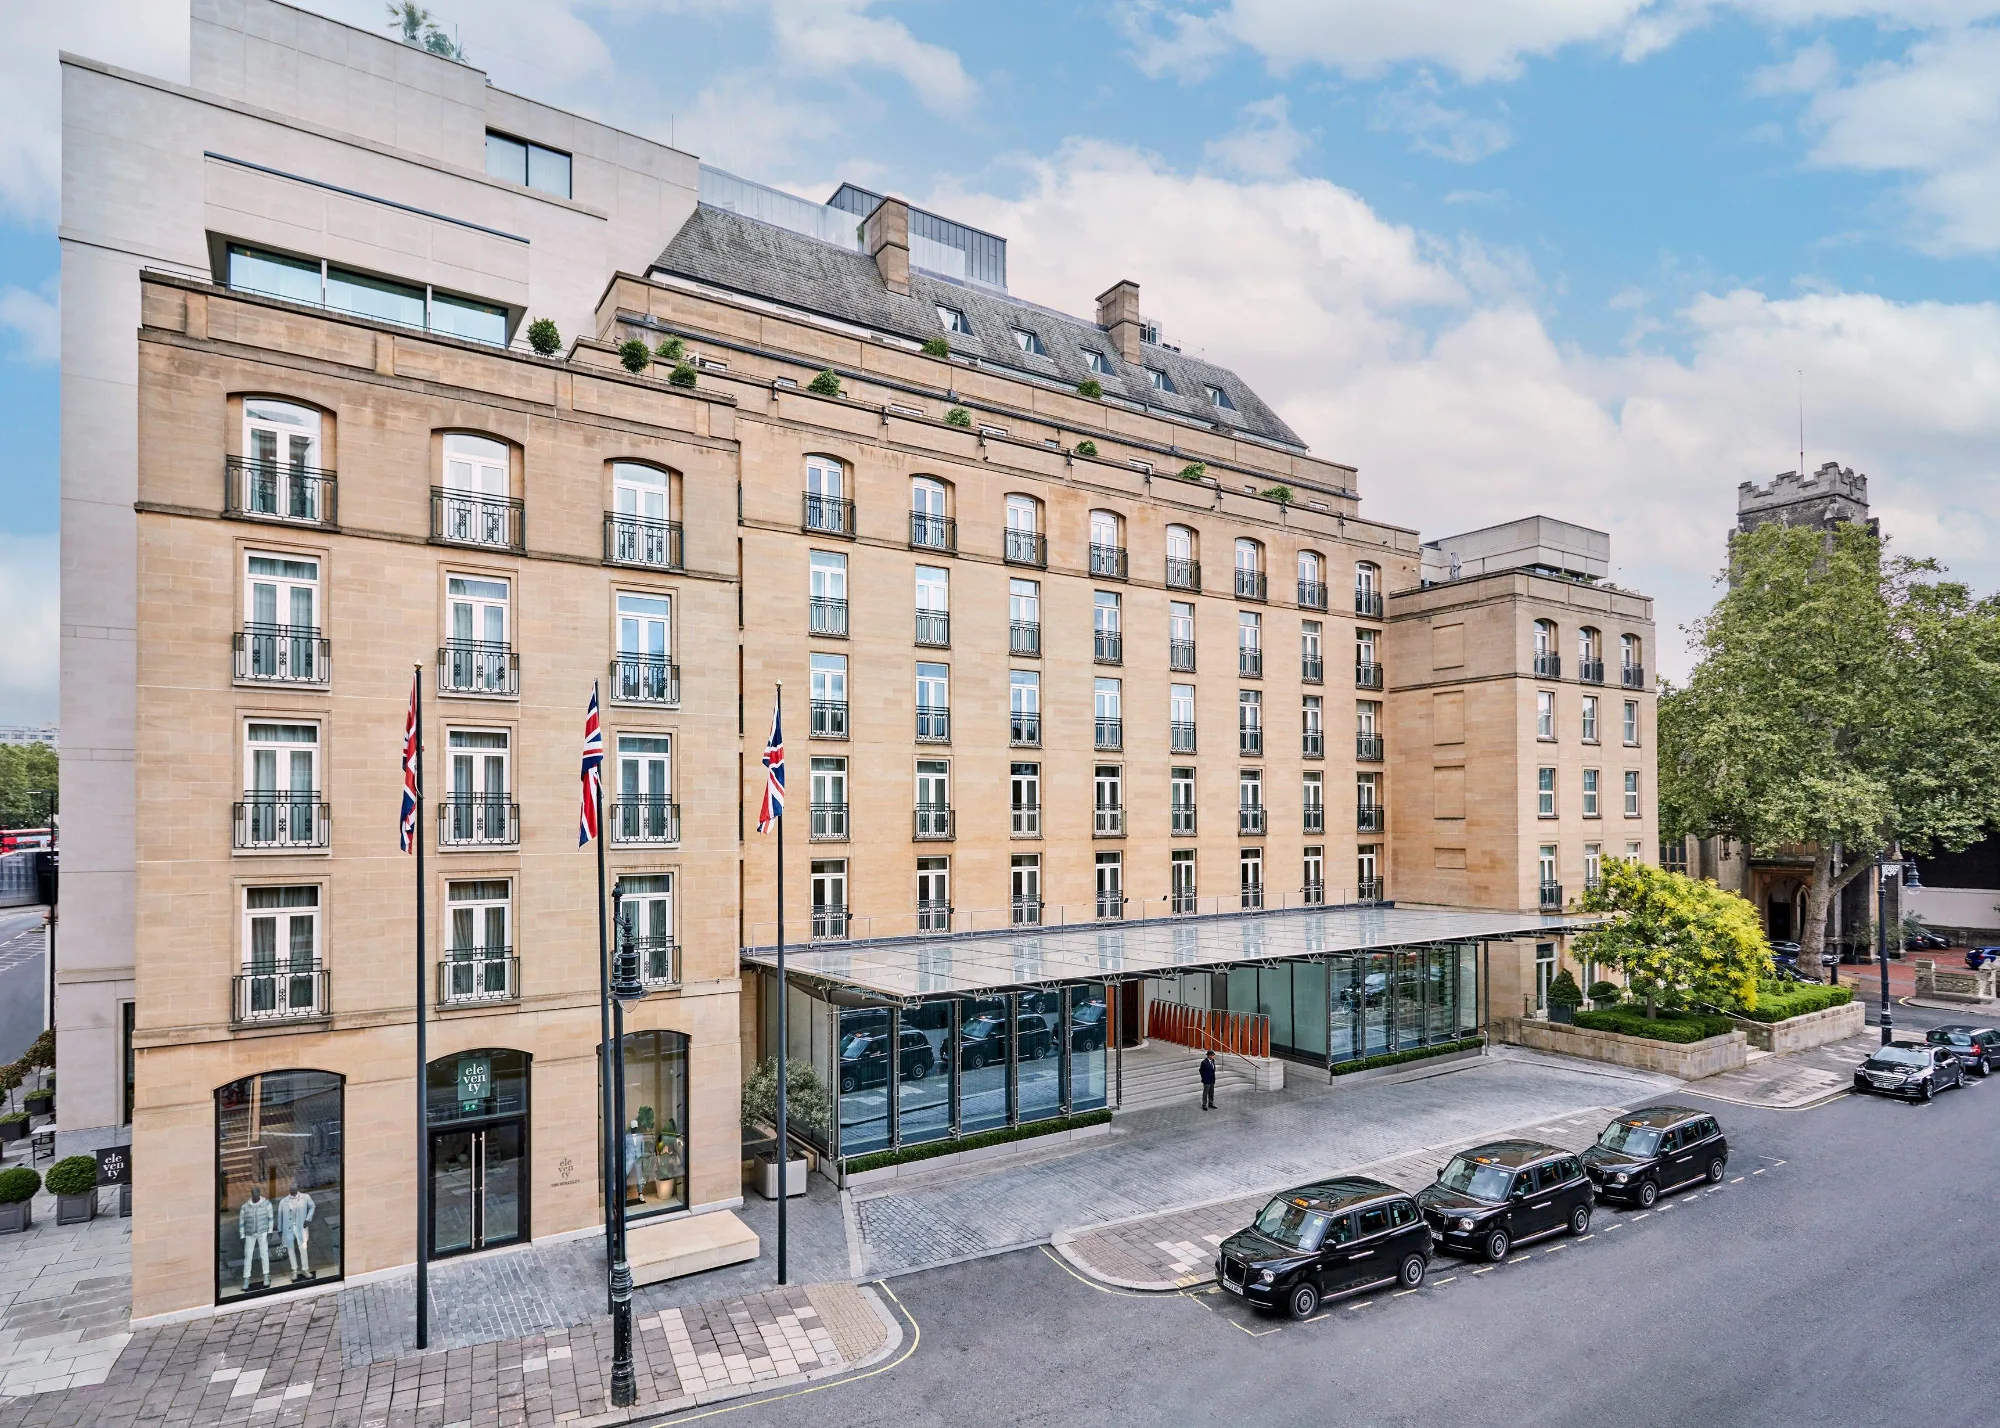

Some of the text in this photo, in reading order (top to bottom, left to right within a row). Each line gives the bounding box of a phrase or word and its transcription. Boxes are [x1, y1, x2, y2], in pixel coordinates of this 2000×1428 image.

[465, 1063, 484, 1075] ele
[463, 1074, 486, 1084] ven
[468, 1082, 481, 1095] ty
[104, 1153, 122, 1164] ele
[559, 1157, 572, 1167] ele
[103, 1162, 124, 1171] ven
[107, 1169, 120, 1180] ty
